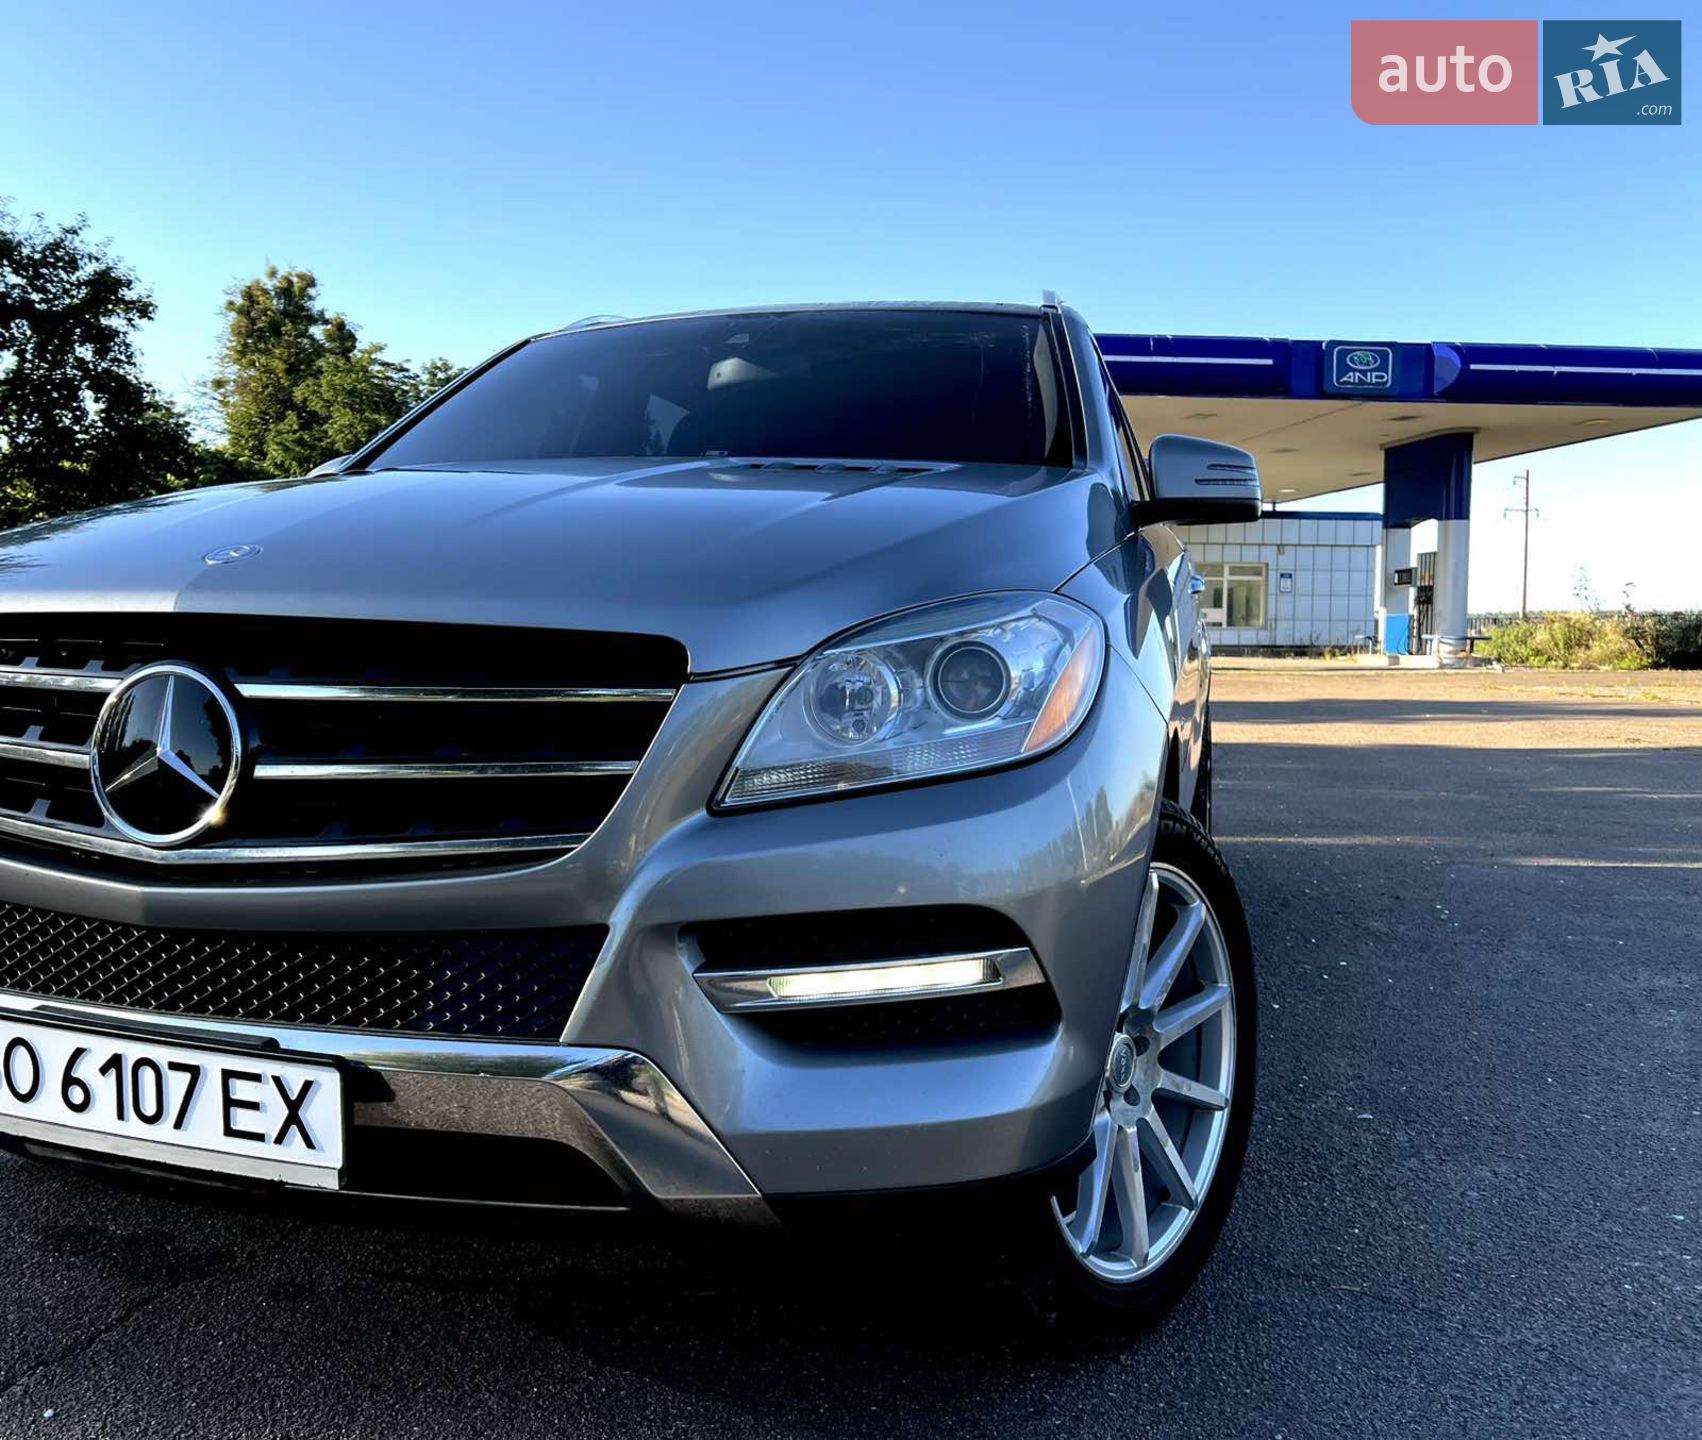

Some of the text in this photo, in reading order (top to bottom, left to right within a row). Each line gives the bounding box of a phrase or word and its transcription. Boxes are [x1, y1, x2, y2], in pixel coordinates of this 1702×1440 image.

[1339, 371, 1388, 383] ANP
[61, 1047, 201, 1131] 6107
[221, 1068, 316, 1150] EX
